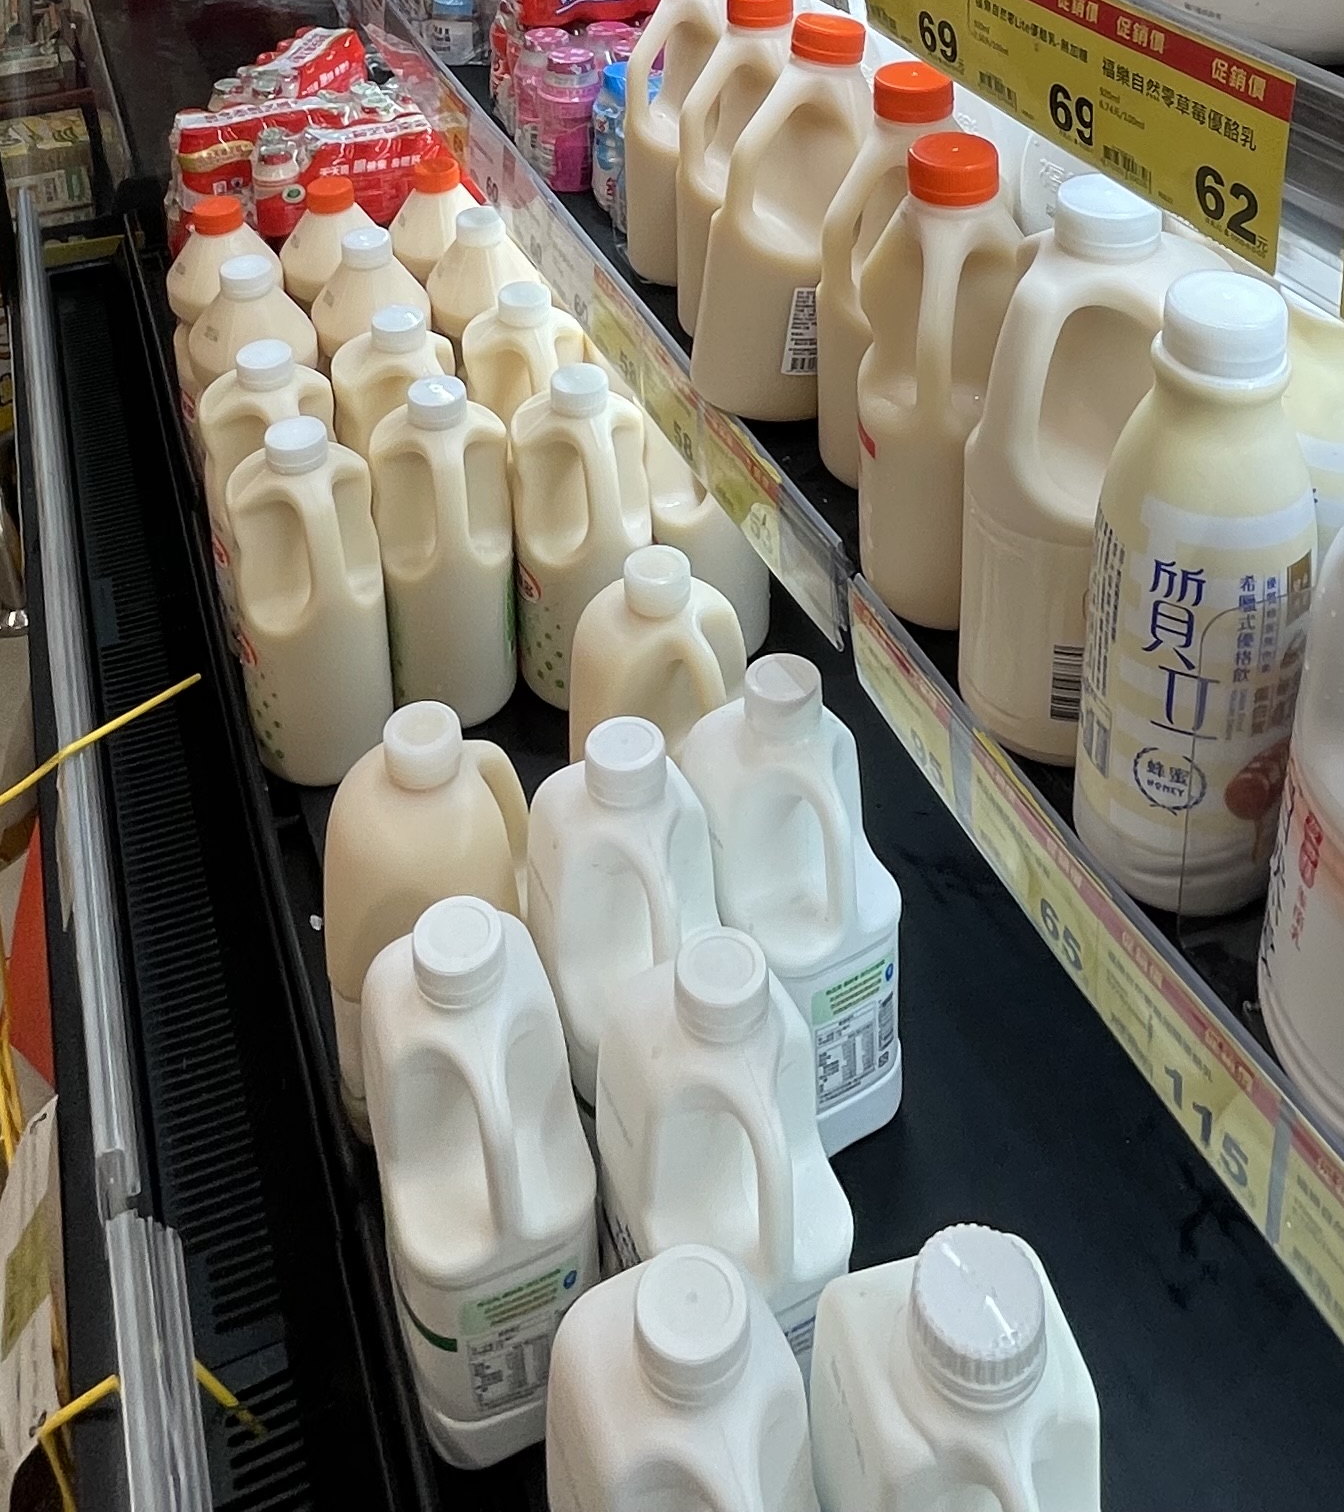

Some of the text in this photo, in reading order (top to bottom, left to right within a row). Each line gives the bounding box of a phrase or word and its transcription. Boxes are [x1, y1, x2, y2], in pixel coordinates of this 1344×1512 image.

[918, 10, 958, 64] 69
[1116, 15, 1167, 55] 促銷價
[1049, 82, 1095, 147] 69
[1101, 56, 1257, 152] 福樂自然零草莓優酪乳
[1211, 57, 1268, 103] 促銷價
[1195, 164, 1259, 244] 62
[1141, 558, 1222, 741] 質立
[1231, 573, 1258, 685] 希臘式優格飲
[1145, 758, 1191, 790] 蜂蜜
[1145, 779, 1186, 800] HONEY
[1038, 897, 1084, 973] 65
[1164, 1064, 1249, 1189] 115
